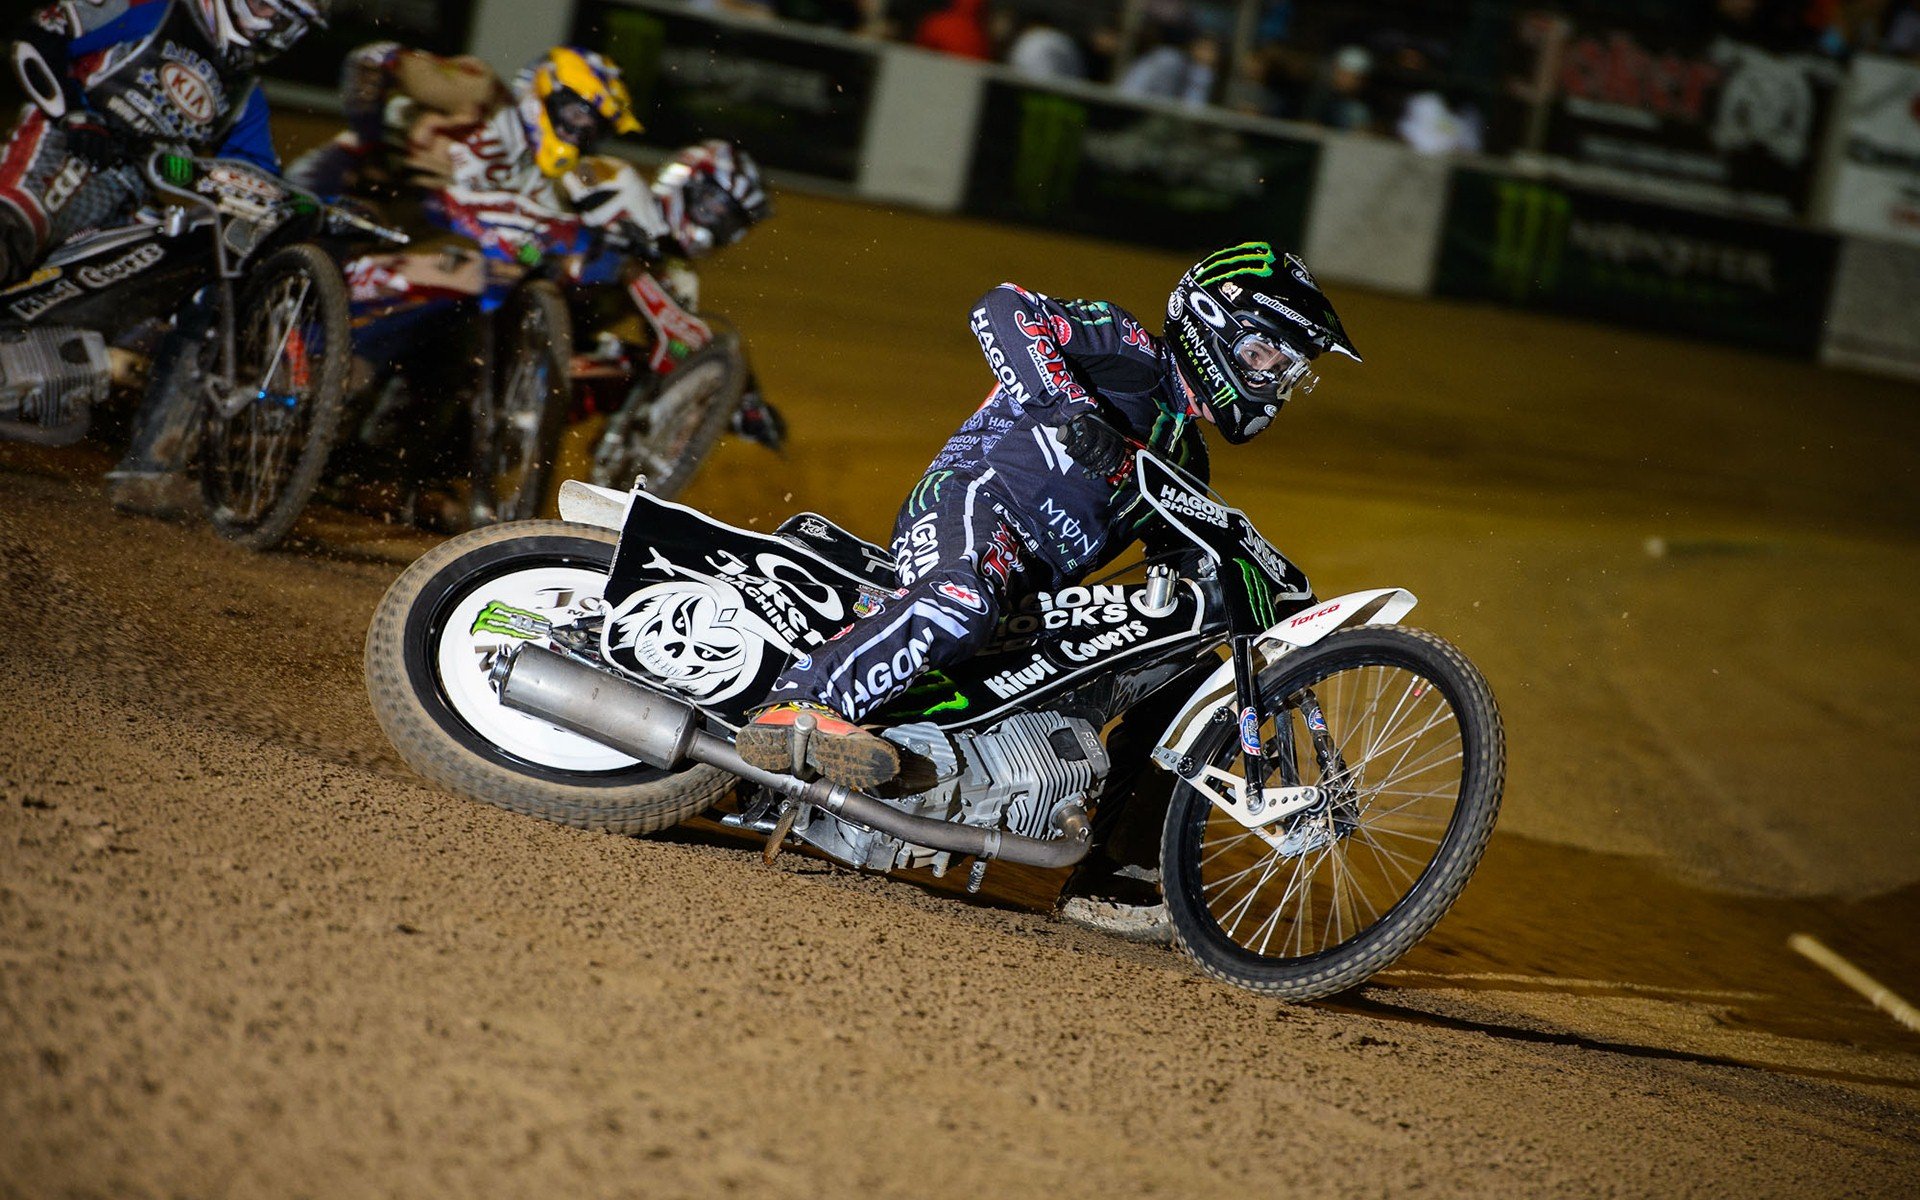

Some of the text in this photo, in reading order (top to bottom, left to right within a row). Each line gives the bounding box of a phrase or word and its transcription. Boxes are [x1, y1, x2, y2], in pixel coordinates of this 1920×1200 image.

[972, 307, 1031, 405] HAGON
[1160, 484, 1229, 522] HAGON
[1160, 498, 1229, 529] SHOCKS
[713, 572, 799, 643] MACHINE
[1289, 603, 1341, 629] Torco
[1059, 619, 1149, 662] Covers
